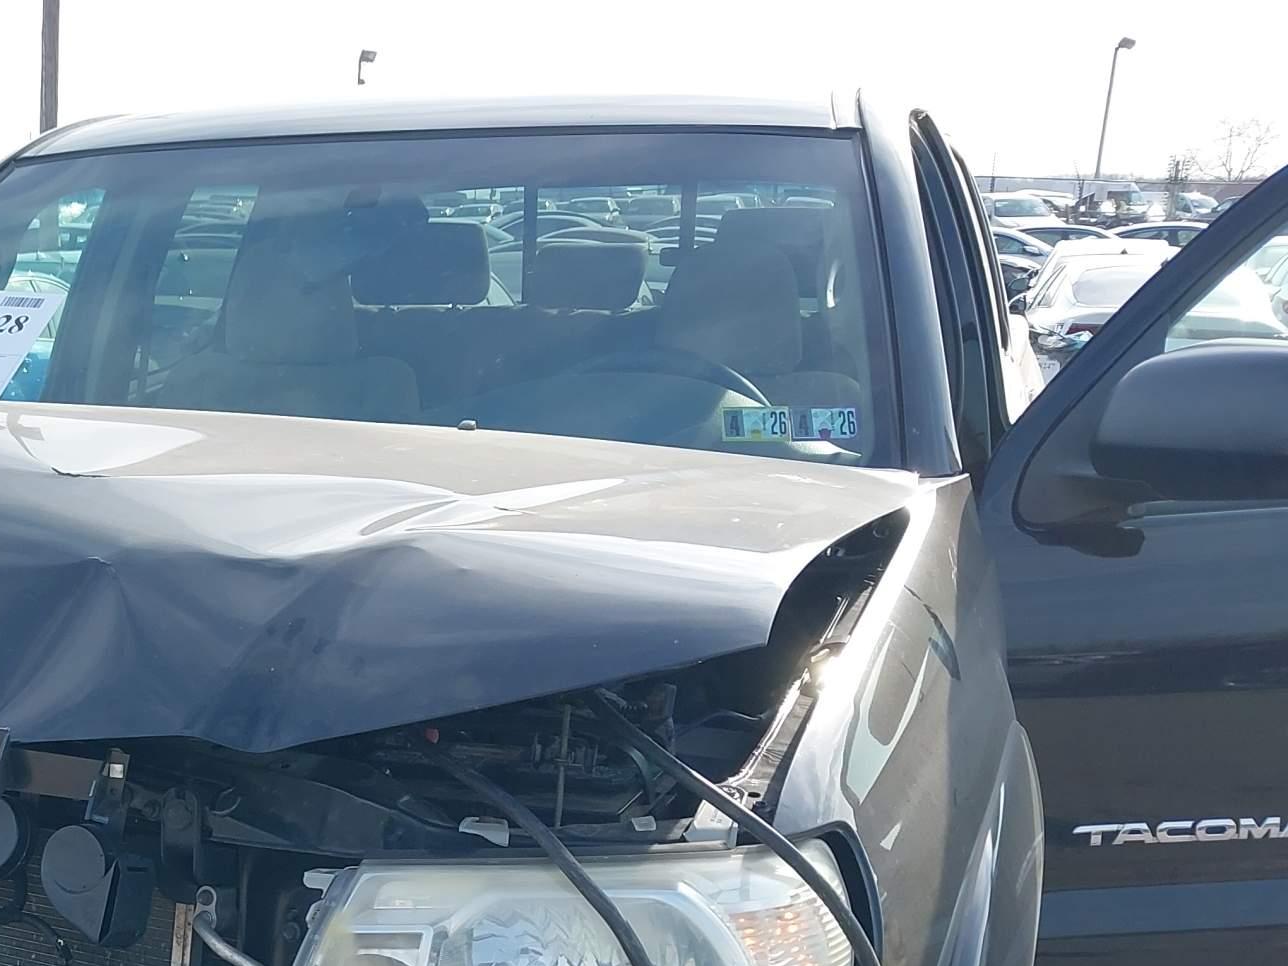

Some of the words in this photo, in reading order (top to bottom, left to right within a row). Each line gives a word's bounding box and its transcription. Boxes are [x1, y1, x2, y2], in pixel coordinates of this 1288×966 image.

[770, 411, 787, 435] 26
[839, 410, 856, 435] 26
[1072, 817, 1288, 846] TACOM
